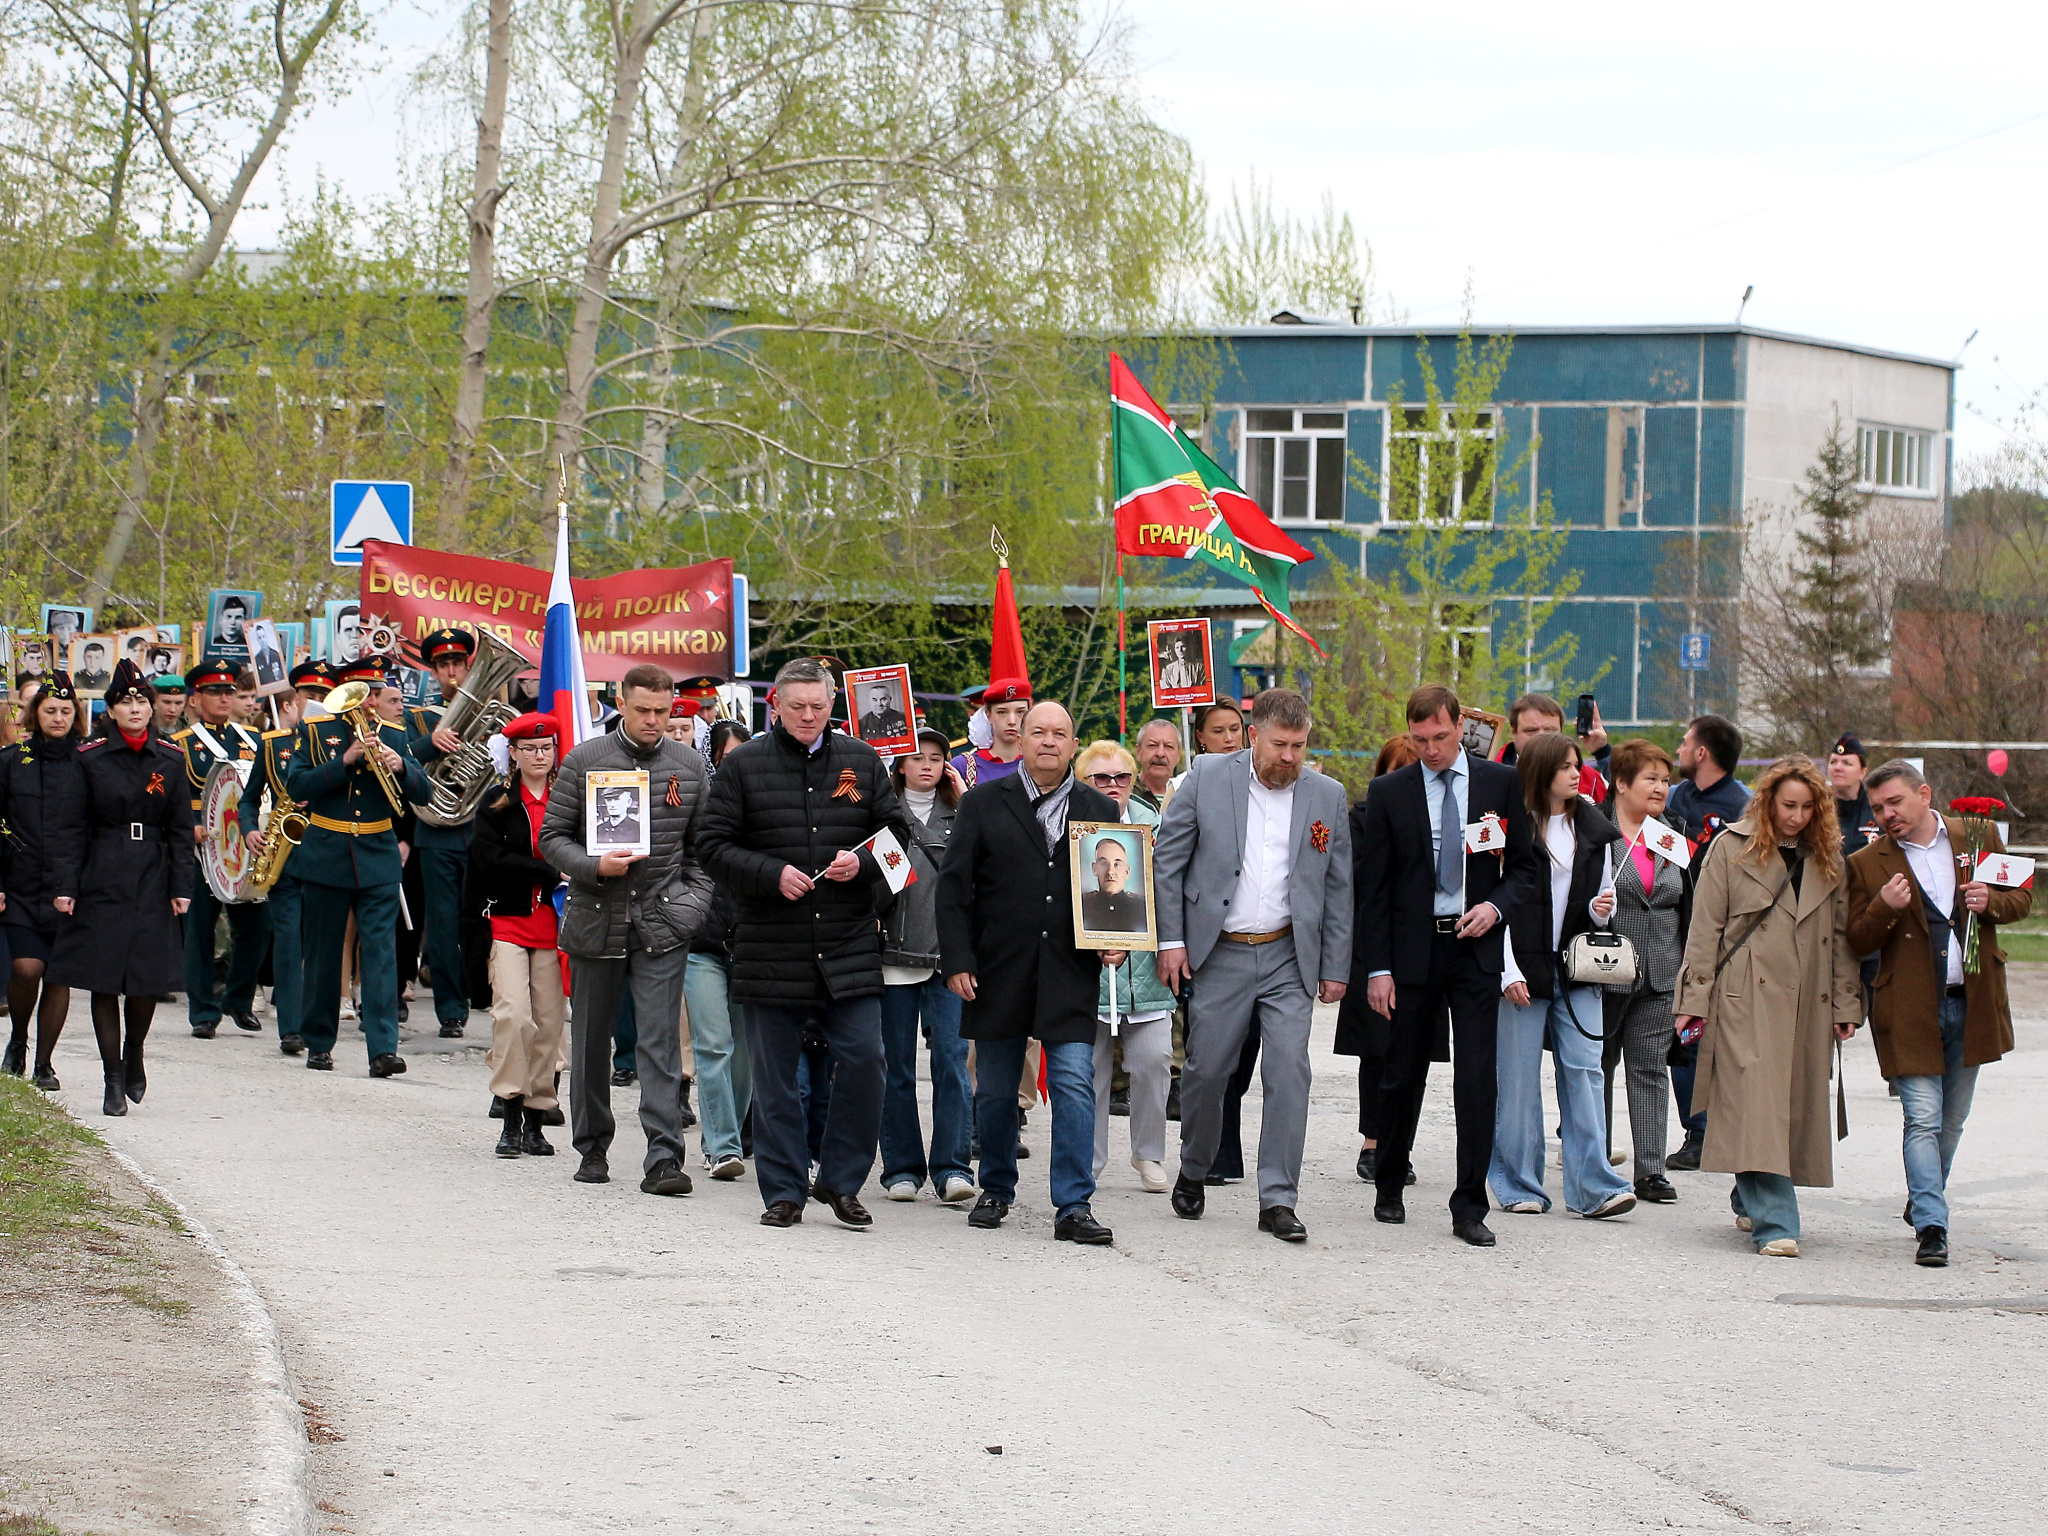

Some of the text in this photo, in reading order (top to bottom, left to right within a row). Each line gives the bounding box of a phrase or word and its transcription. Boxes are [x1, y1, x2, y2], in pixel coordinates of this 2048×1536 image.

[1139, 523, 1257, 576] ГРАНИЦА Н
[369, 559, 691, 620] Бессмертнй полк
[524, 625, 728, 656] «млянка»
